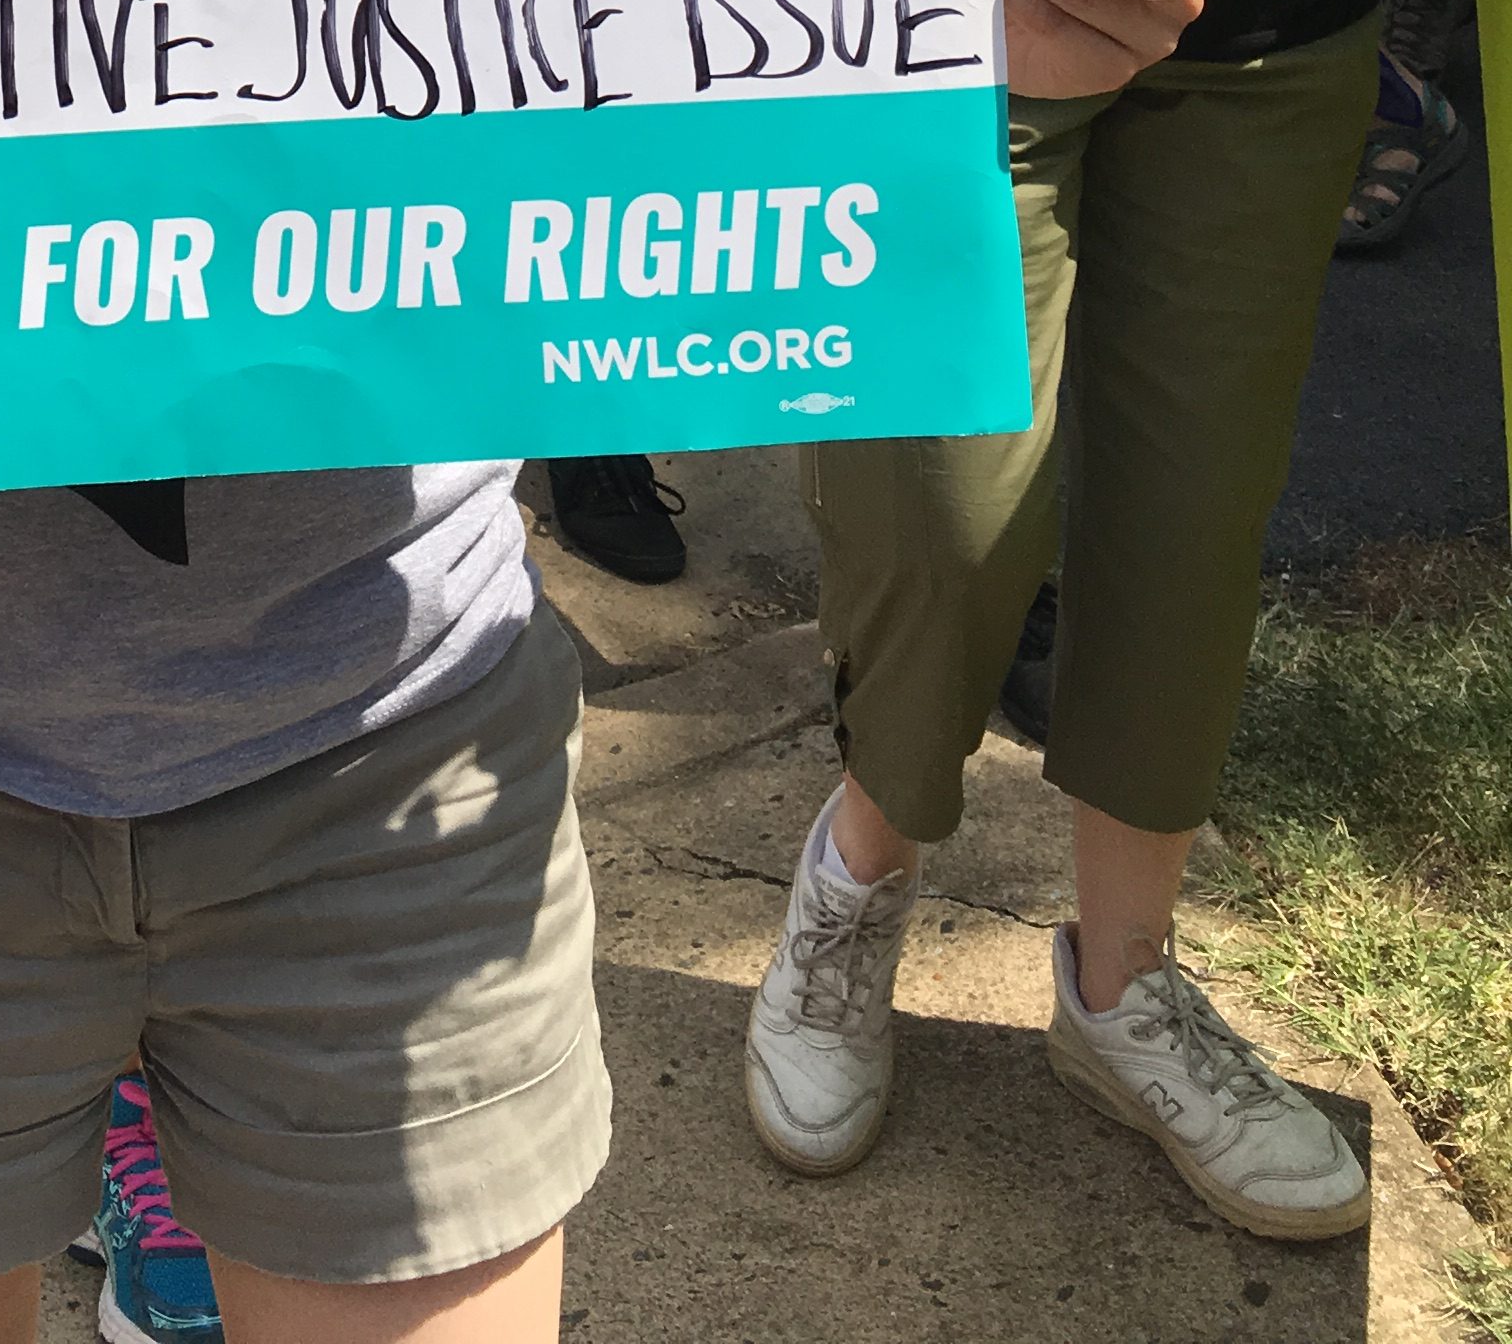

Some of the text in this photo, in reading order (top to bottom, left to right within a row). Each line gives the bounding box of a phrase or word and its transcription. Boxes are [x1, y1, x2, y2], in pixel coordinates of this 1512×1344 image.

[18, 216, 216, 332] FOR
[252, 203, 467, 317] OUR
[503, 182, 880, 304] RIGHTS
[542, 324, 853, 385] NWLC.ORG
